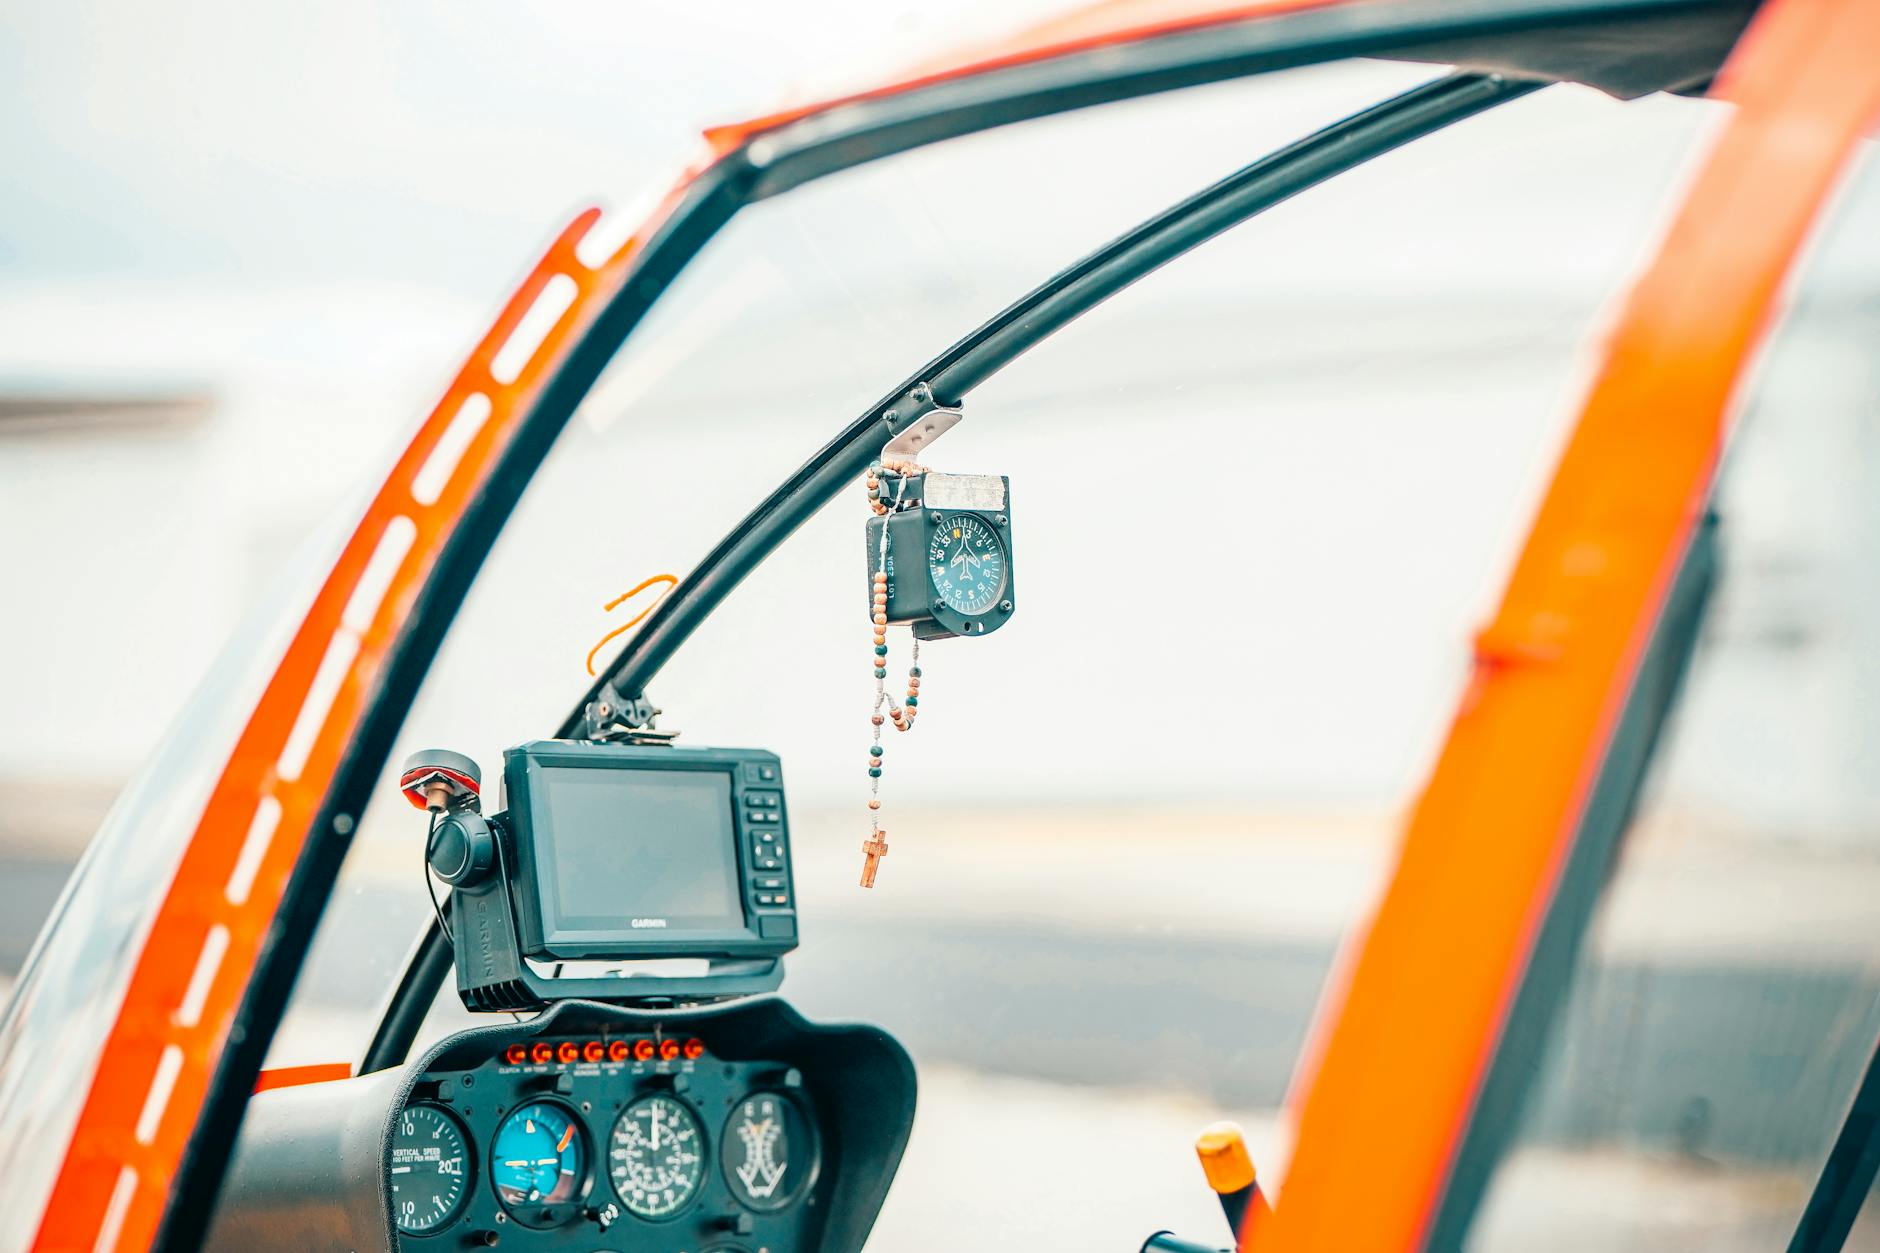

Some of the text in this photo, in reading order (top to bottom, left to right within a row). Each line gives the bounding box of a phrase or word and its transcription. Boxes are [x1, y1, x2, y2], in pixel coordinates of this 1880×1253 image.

[953, 528, 961, 538] N
[966, 530, 972, 539] 3
[941, 535, 951, 547] 33
[937, 549, 944, 561] 30
[977, 582, 985, 592] 15
[968, 590, 974, 599] S
[631, 918, 667, 929] GARMIN
[478, 902, 494, 980] GARMIN
[402, 1123, 414, 1136] 10
[432, 1131, 440, 1139] 15
[393, 1147, 441, 1157] VERTICAL SPEED
[438, 1160, 452, 1174] 20
[432, 1195, 440, 1203] 15
[402, 1201, 415, 1215] 10
